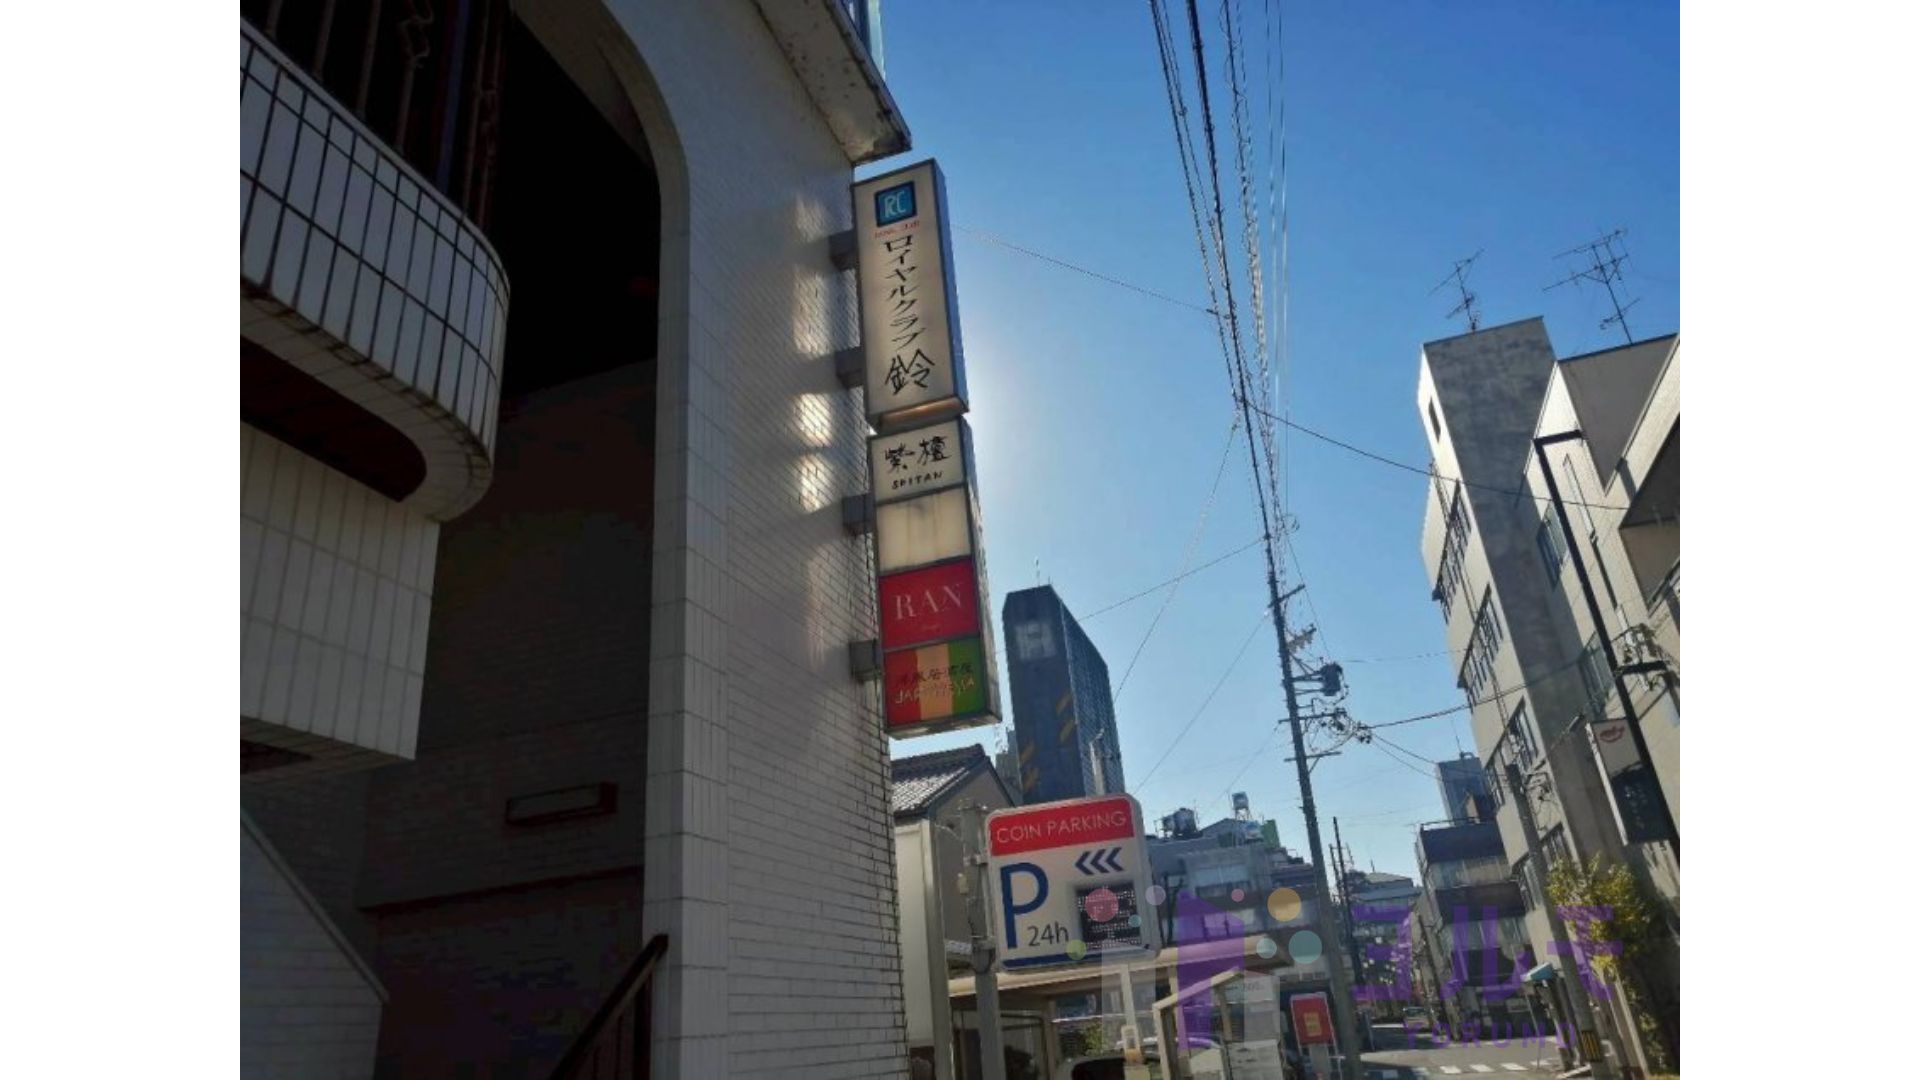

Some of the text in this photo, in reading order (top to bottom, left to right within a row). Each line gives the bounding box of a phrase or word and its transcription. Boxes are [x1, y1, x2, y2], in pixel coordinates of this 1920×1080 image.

[894, 582, 964, 620] RAN
[997, 811, 1127, 843] COIN PARKING
[1001, 862, 1049, 949] P
[1027, 921, 1070, 947] 24h
